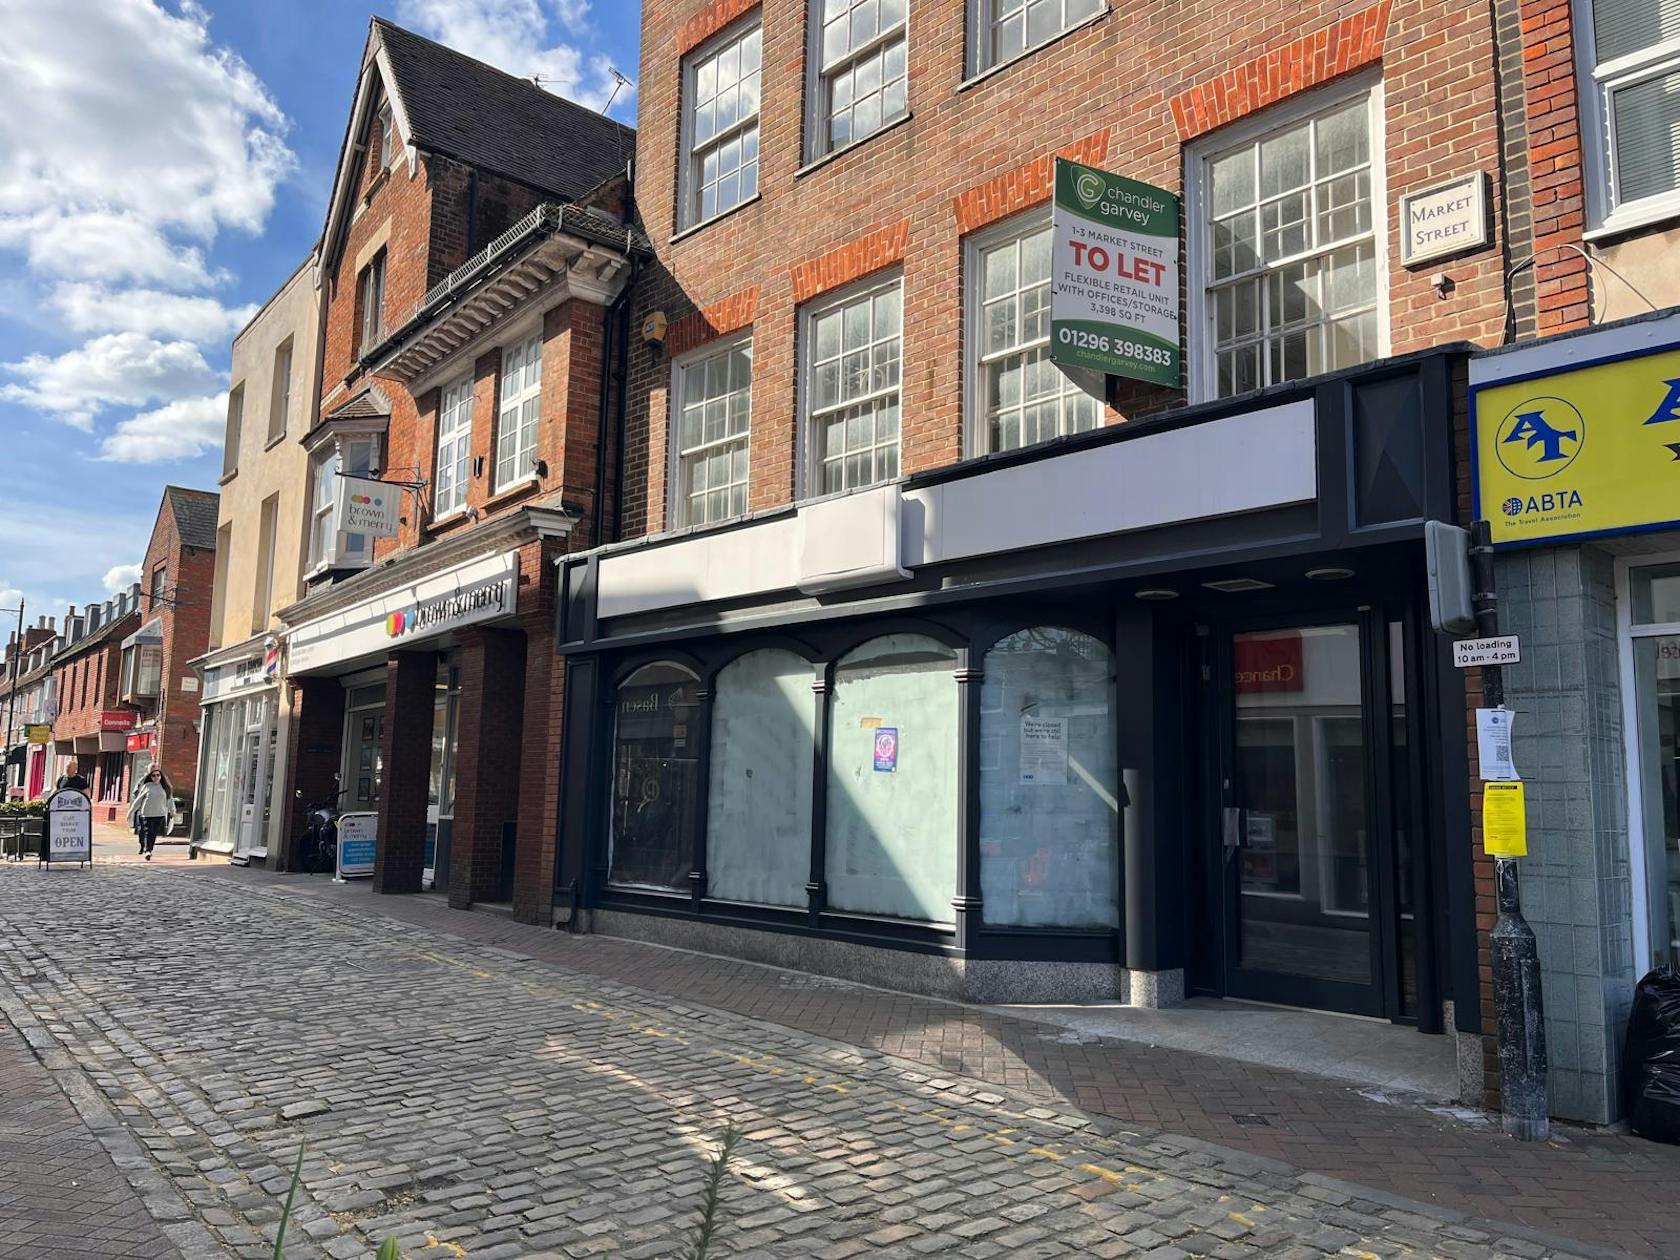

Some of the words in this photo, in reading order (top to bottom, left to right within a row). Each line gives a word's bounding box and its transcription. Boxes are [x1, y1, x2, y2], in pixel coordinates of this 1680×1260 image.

[1107, 186, 1166, 214] chandler
[1411, 195, 1473, 224] MARKET
[1100, 201, 1150, 226] garvey
[1072, 226, 1086, 237] 1-3
[1088, 230, 1127, 248] MARKET
[1130, 240, 1164, 258] STREET
[1415, 220, 1470, 245] STREET
[1068, 240, 1110, 272] TO
[1117, 253, 1166, 287] LET
[1058, 282, 1085, 297] WITH
[1087, 289, 1176, 320] OFFICES/STORAGE
[1065, 272, 1111, 290] FLEXIBLE
[1113, 283, 1147, 299] RETAIL
[1148, 293, 1170, 305] UNIT
[1090, 302, 1116, 317] 3,398
[1119, 309, 1132, 321] SQ
[1134, 314, 1147, 324] FT
[1059, 327, 1110, 352] 01296
[1114, 339, 1171, 366] 398383
[1076, 349, 1156, 373] chandlergarvey.com
[349, 504, 384, 519] brown
[1525, 490, 1583, 514] ABTA
[1518, 517, 1538, 525] Travel
[1457, 655, 1469, 663] 10
[1491, 652, 1499, 660] 4
[1500, 652, 1516, 660] pm
[1460, 643, 1474, 651] No
[1476, 640, 1512, 650] loading
[55, 836, 84, 848] OPEN
